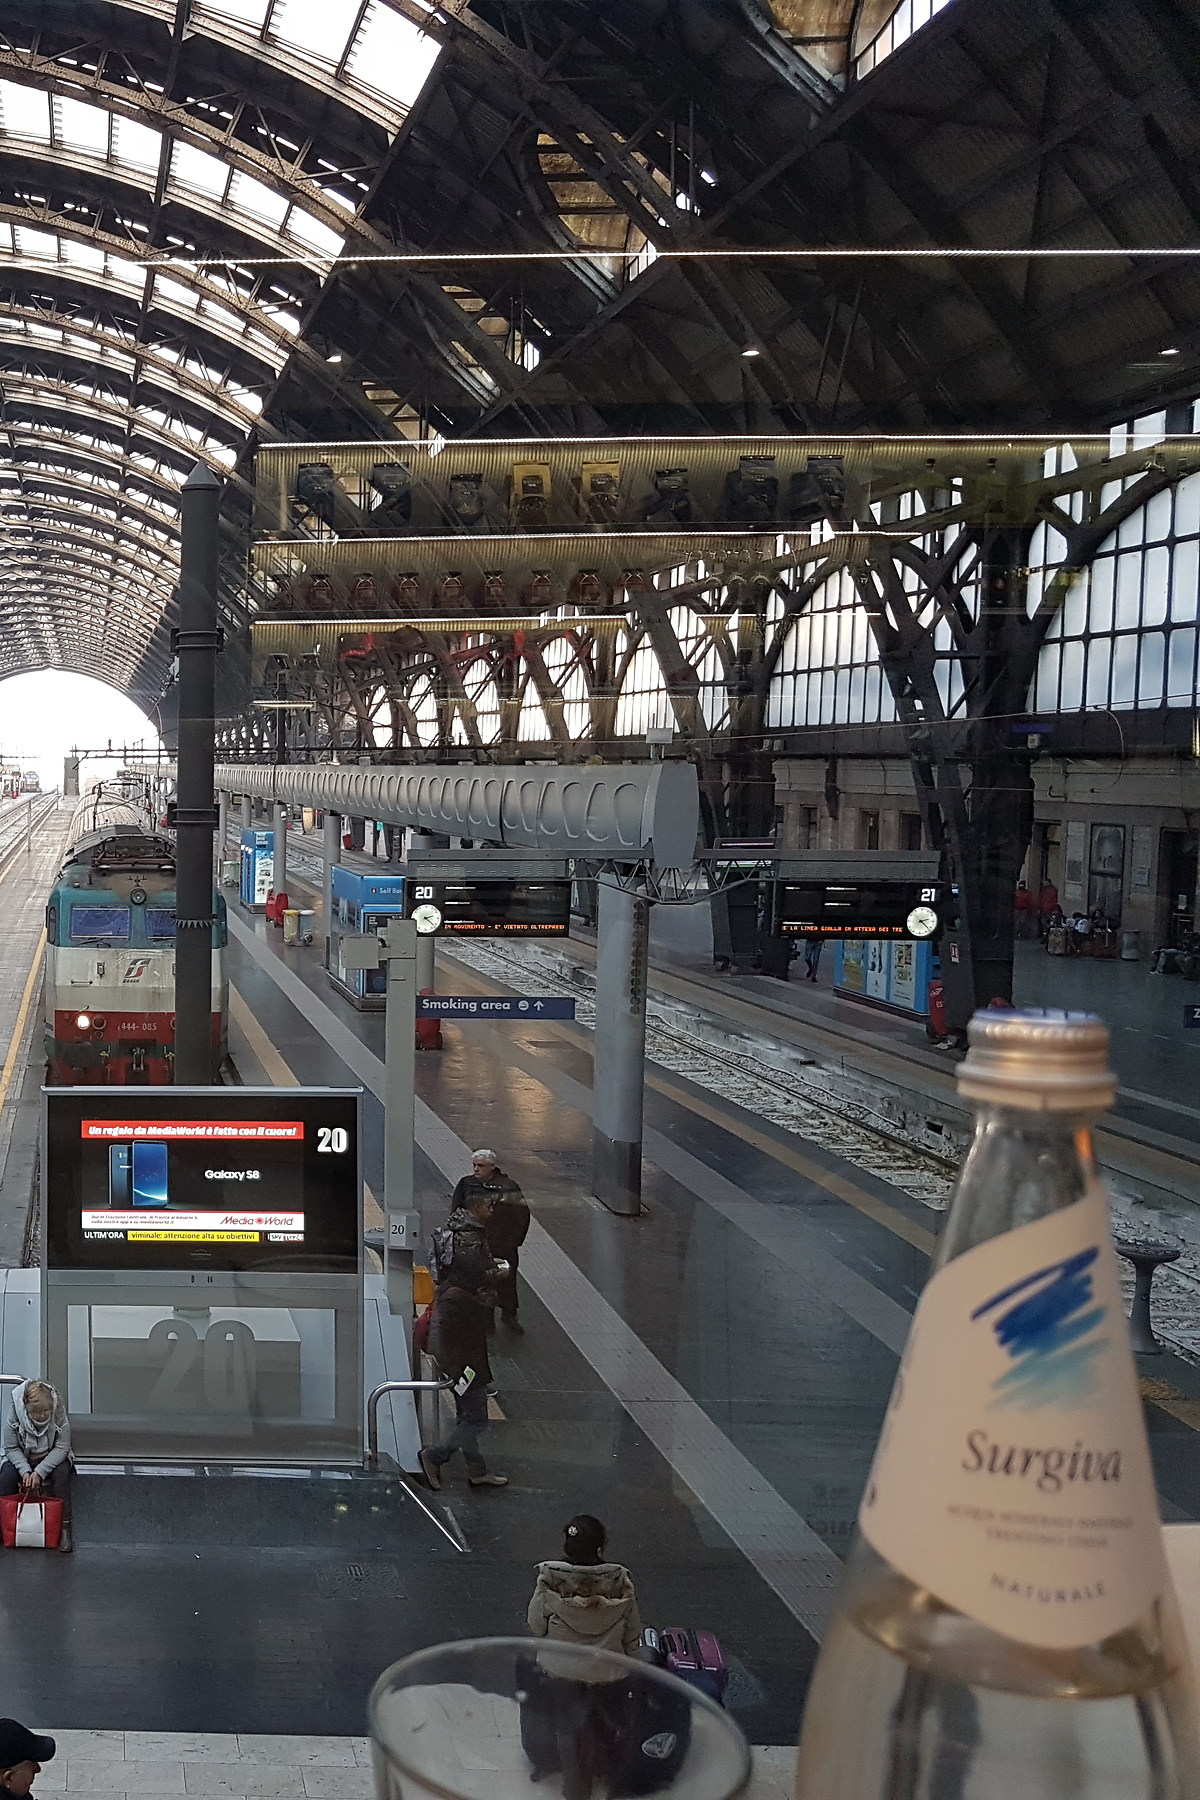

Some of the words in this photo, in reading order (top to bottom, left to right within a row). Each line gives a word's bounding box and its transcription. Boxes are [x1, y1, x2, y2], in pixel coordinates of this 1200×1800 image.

[415, 886, 433, 899] 20
[920, 888, 936, 902] 21
[422, 999, 477, 1011] Smoking
[481, 1000, 511, 1010] area
[88, 1126, 102, 1135] Un
[102, 1126, 134, 1136] regalo
[134, 1126, 147, 1135] da
[147, 1126, 206, 1136] MediaWorld
[213, 1127, 238, 1136] fatto
[239, 1128, 257, 1136] con
[257, 1127, 265, 1136] il
[265, 1128, 297, 1136] cuore!
[316, 1127, 348, 1153] 20
[204, 1170, 245, 1181] Galaxy
[246, 1170, 260, 1180] S8
[220, 1216, 254, 1226] Media
[263, 1216, 294, 1226] World
[84, 1231, 125, 1239] ULTIM'ORA
[131, 1231, 163, 1239] viminale:
[164, 1231, 200, 1239] attenzione
[226, 1232, 255, 1240] obiettivi
[391, 1224, 405, 1235] 20
[148, 1319, 256, 1411] 20
[960, 1428, 1123, 1493] Surgiva
[990, 1572, 1106, 1604] NATURALE
